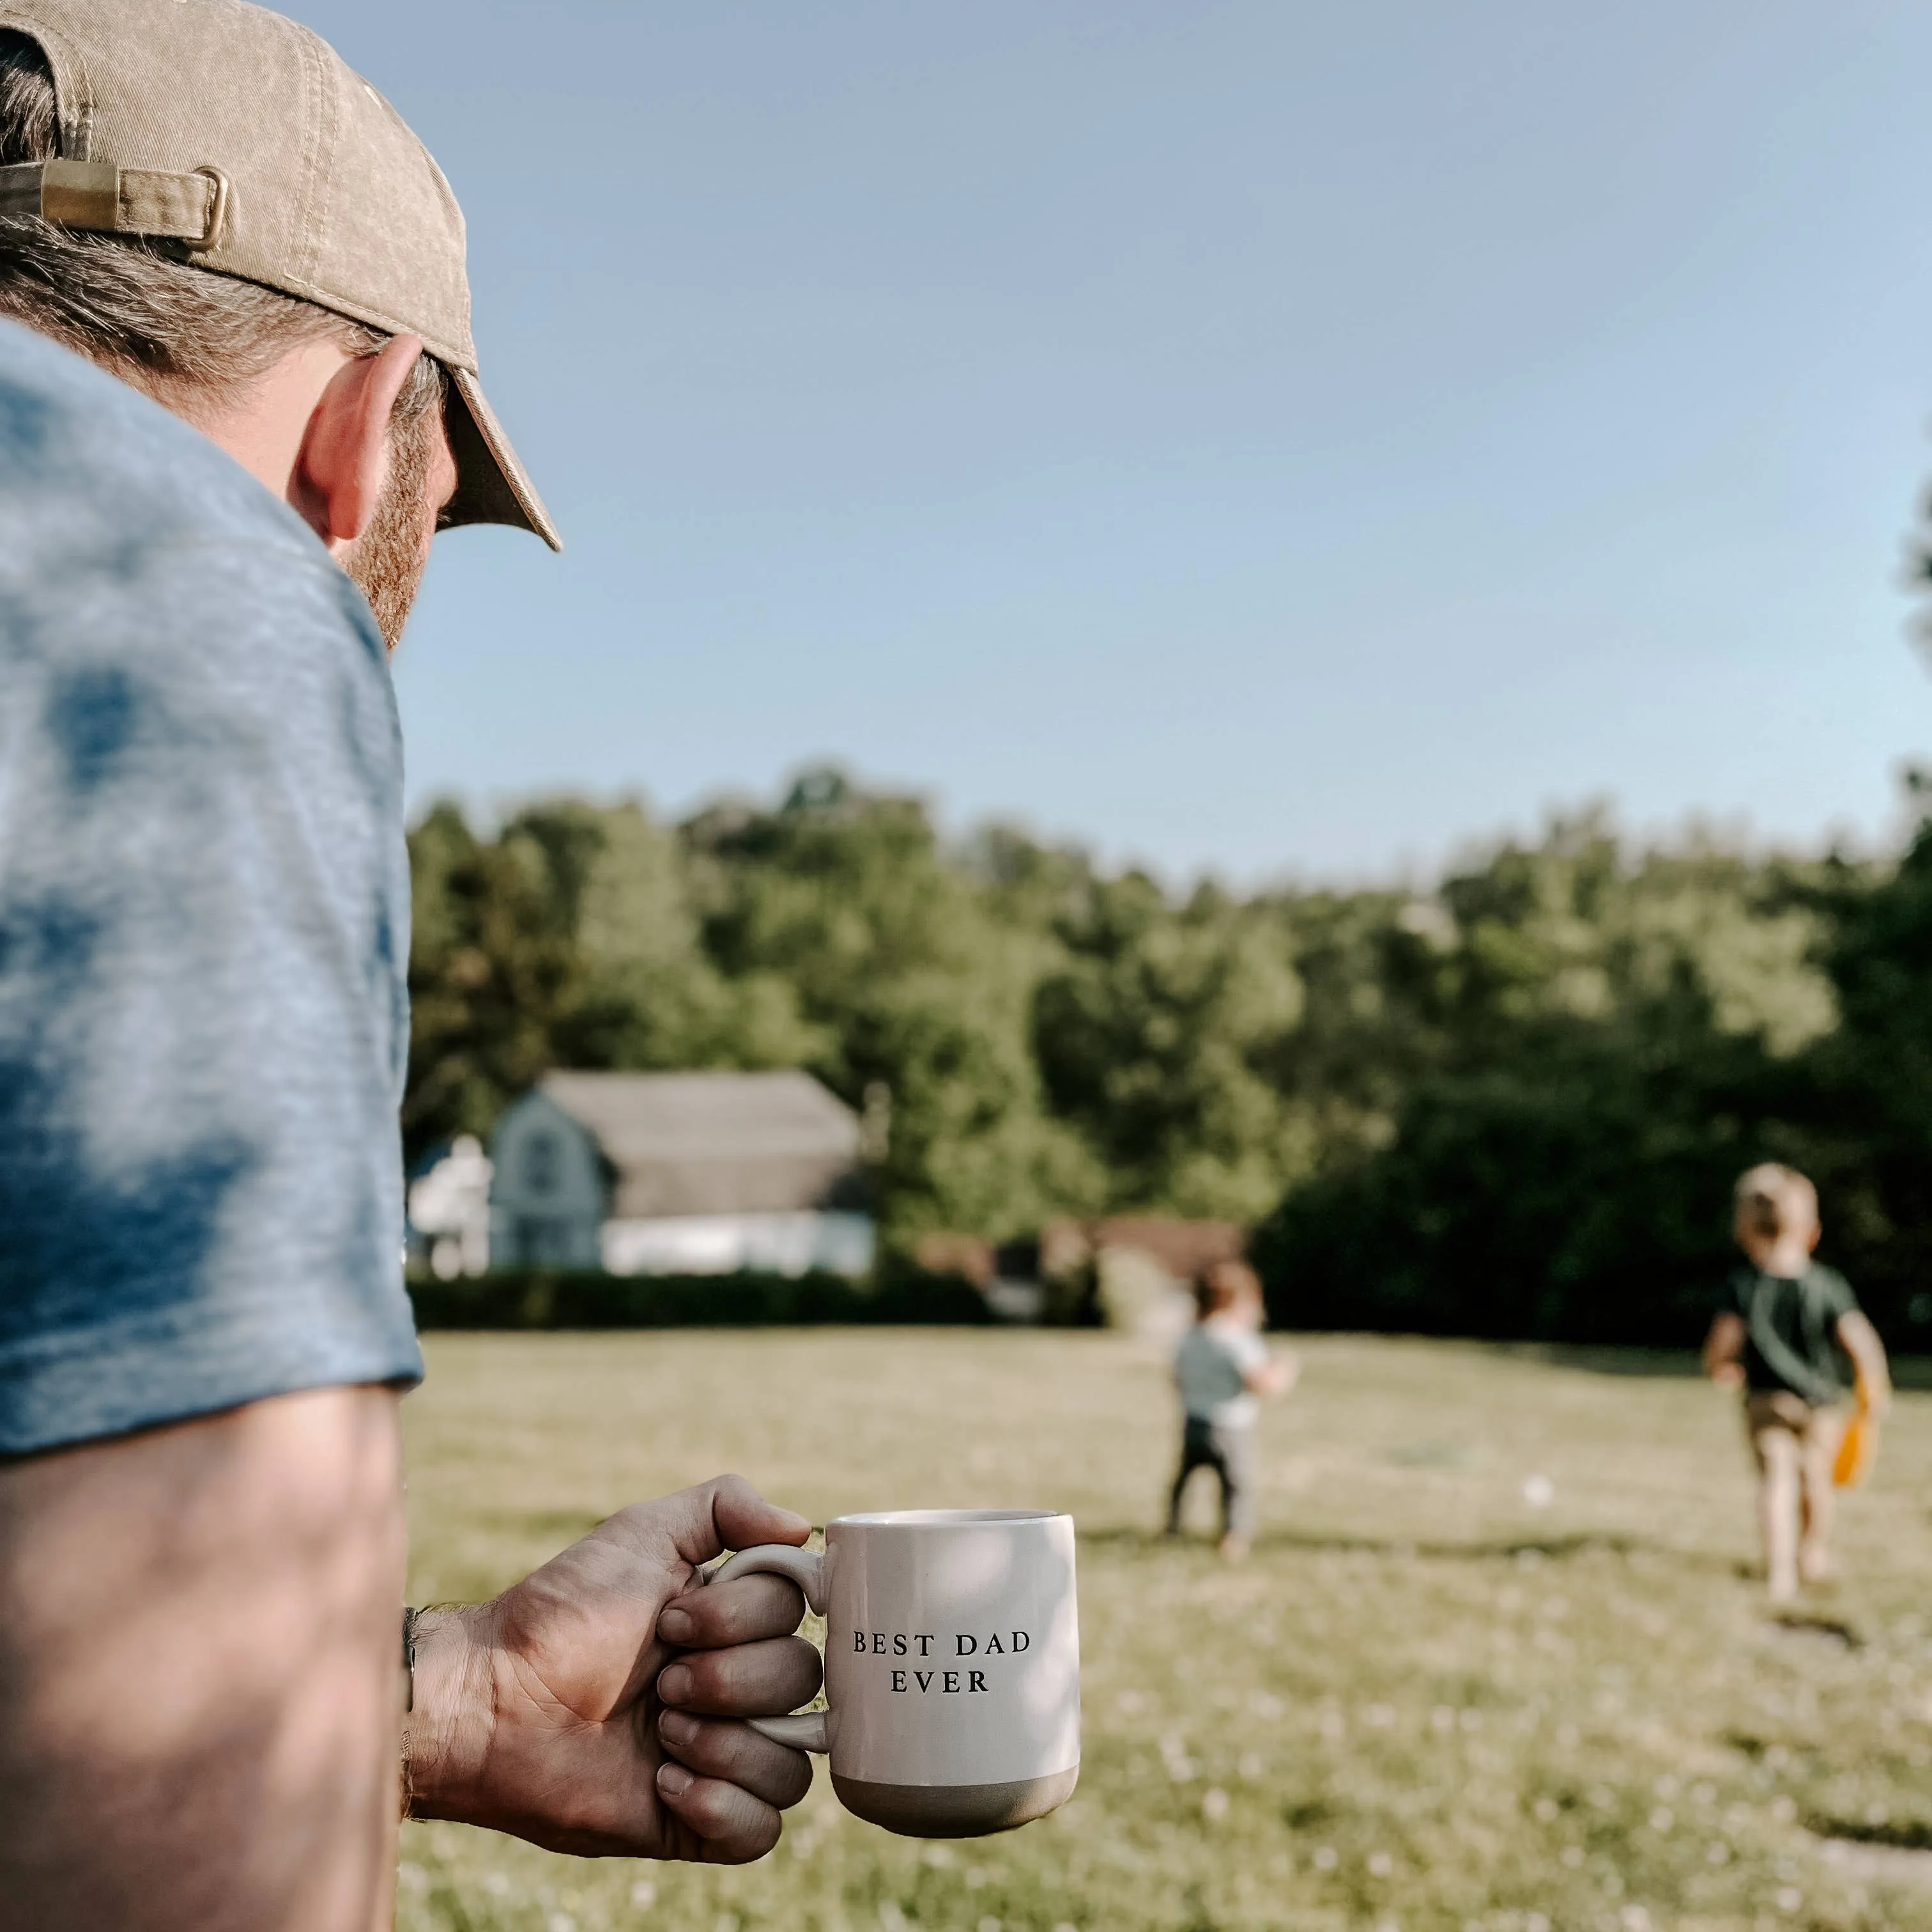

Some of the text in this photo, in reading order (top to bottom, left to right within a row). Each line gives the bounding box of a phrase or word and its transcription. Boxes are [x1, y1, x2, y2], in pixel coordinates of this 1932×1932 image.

[853, 1630, 1031, 1657] BEST DAD
[890, 1670, 990, 1694] EVER
